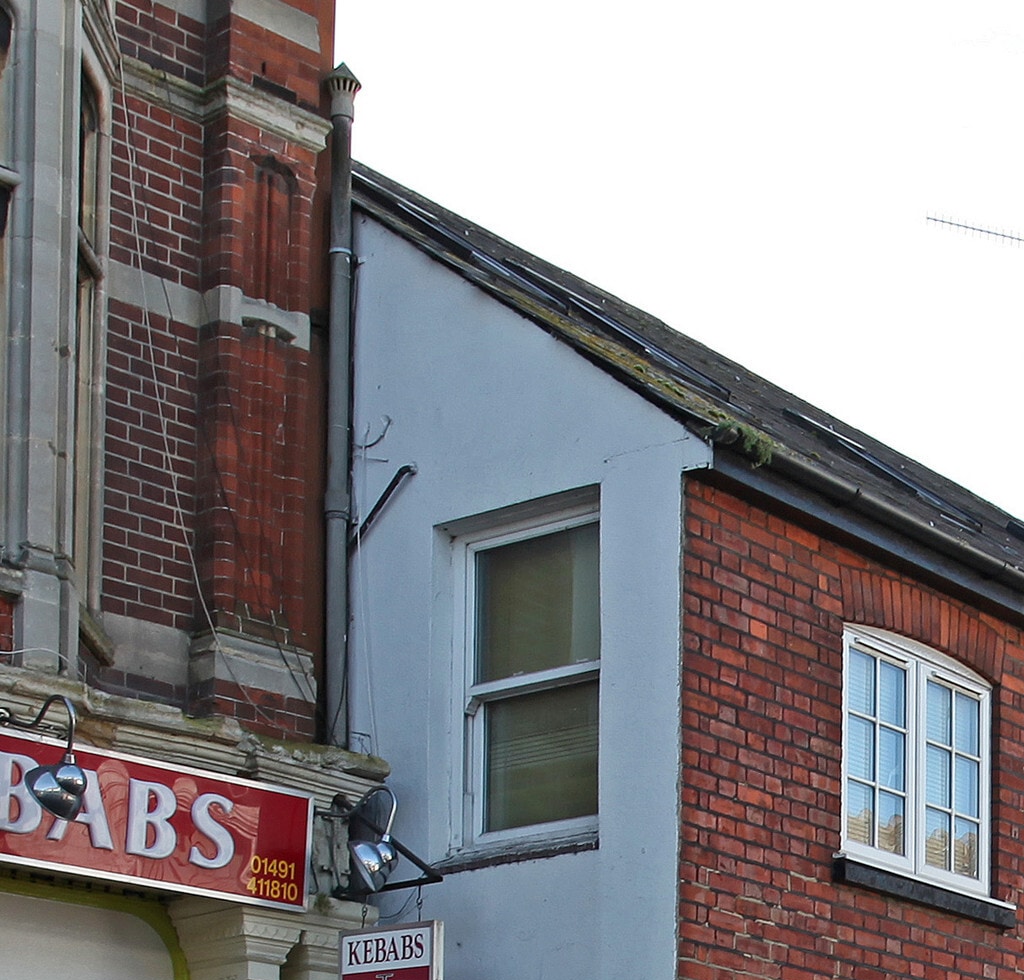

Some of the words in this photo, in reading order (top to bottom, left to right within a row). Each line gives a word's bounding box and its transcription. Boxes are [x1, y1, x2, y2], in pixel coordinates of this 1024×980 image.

[250, 855, 296, 880] 01491
[246, 879, 298, 902] 411810
[347, 933, 425, 967] KEBABS
